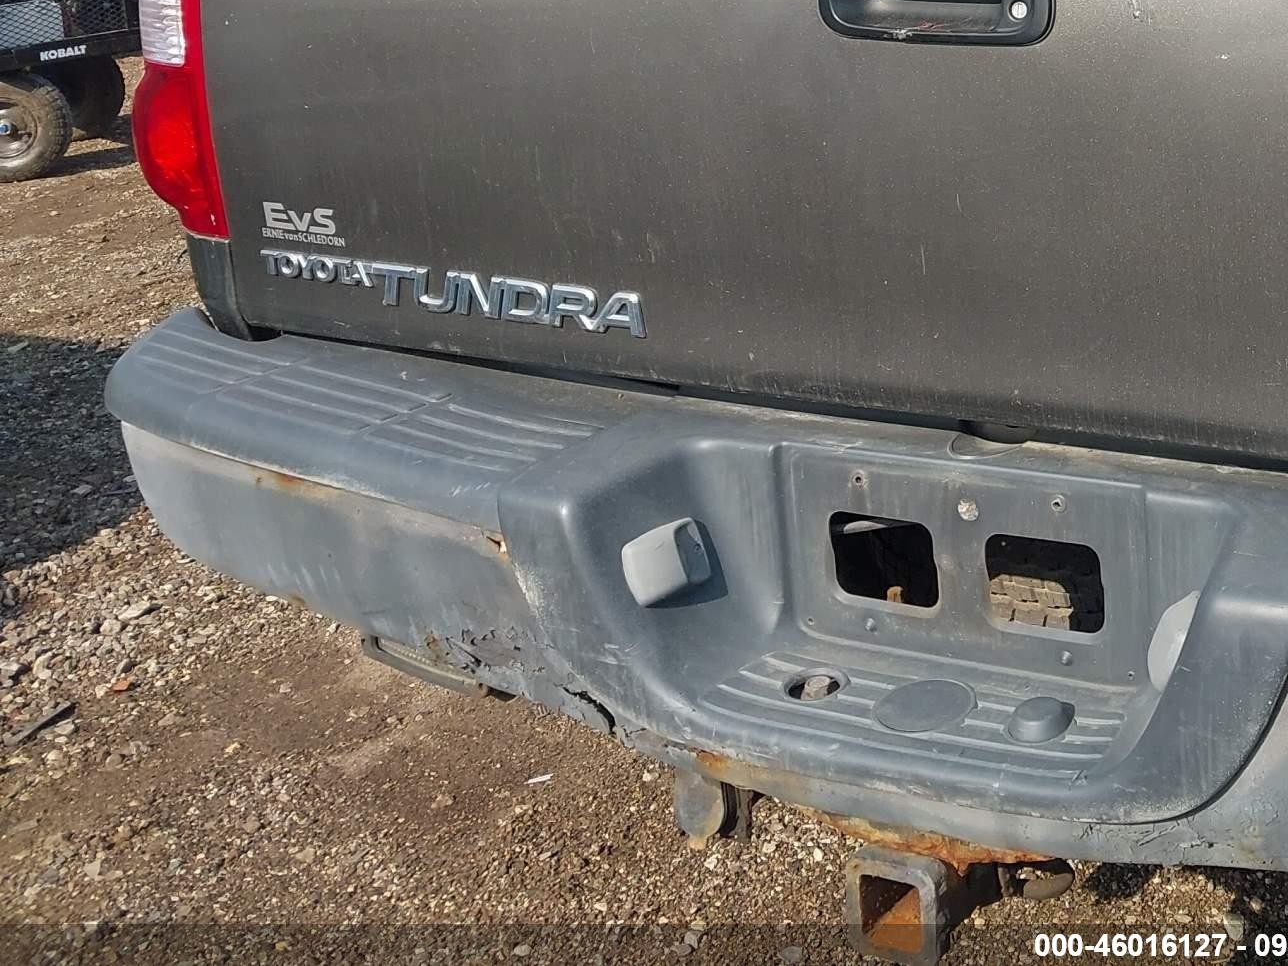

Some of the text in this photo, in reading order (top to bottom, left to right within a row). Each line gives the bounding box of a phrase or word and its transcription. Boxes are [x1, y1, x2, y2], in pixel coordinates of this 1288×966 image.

[40, 44, 87, 61] KOBALT
[260, 249, 648, 339] TOYOTA TUNDRA
